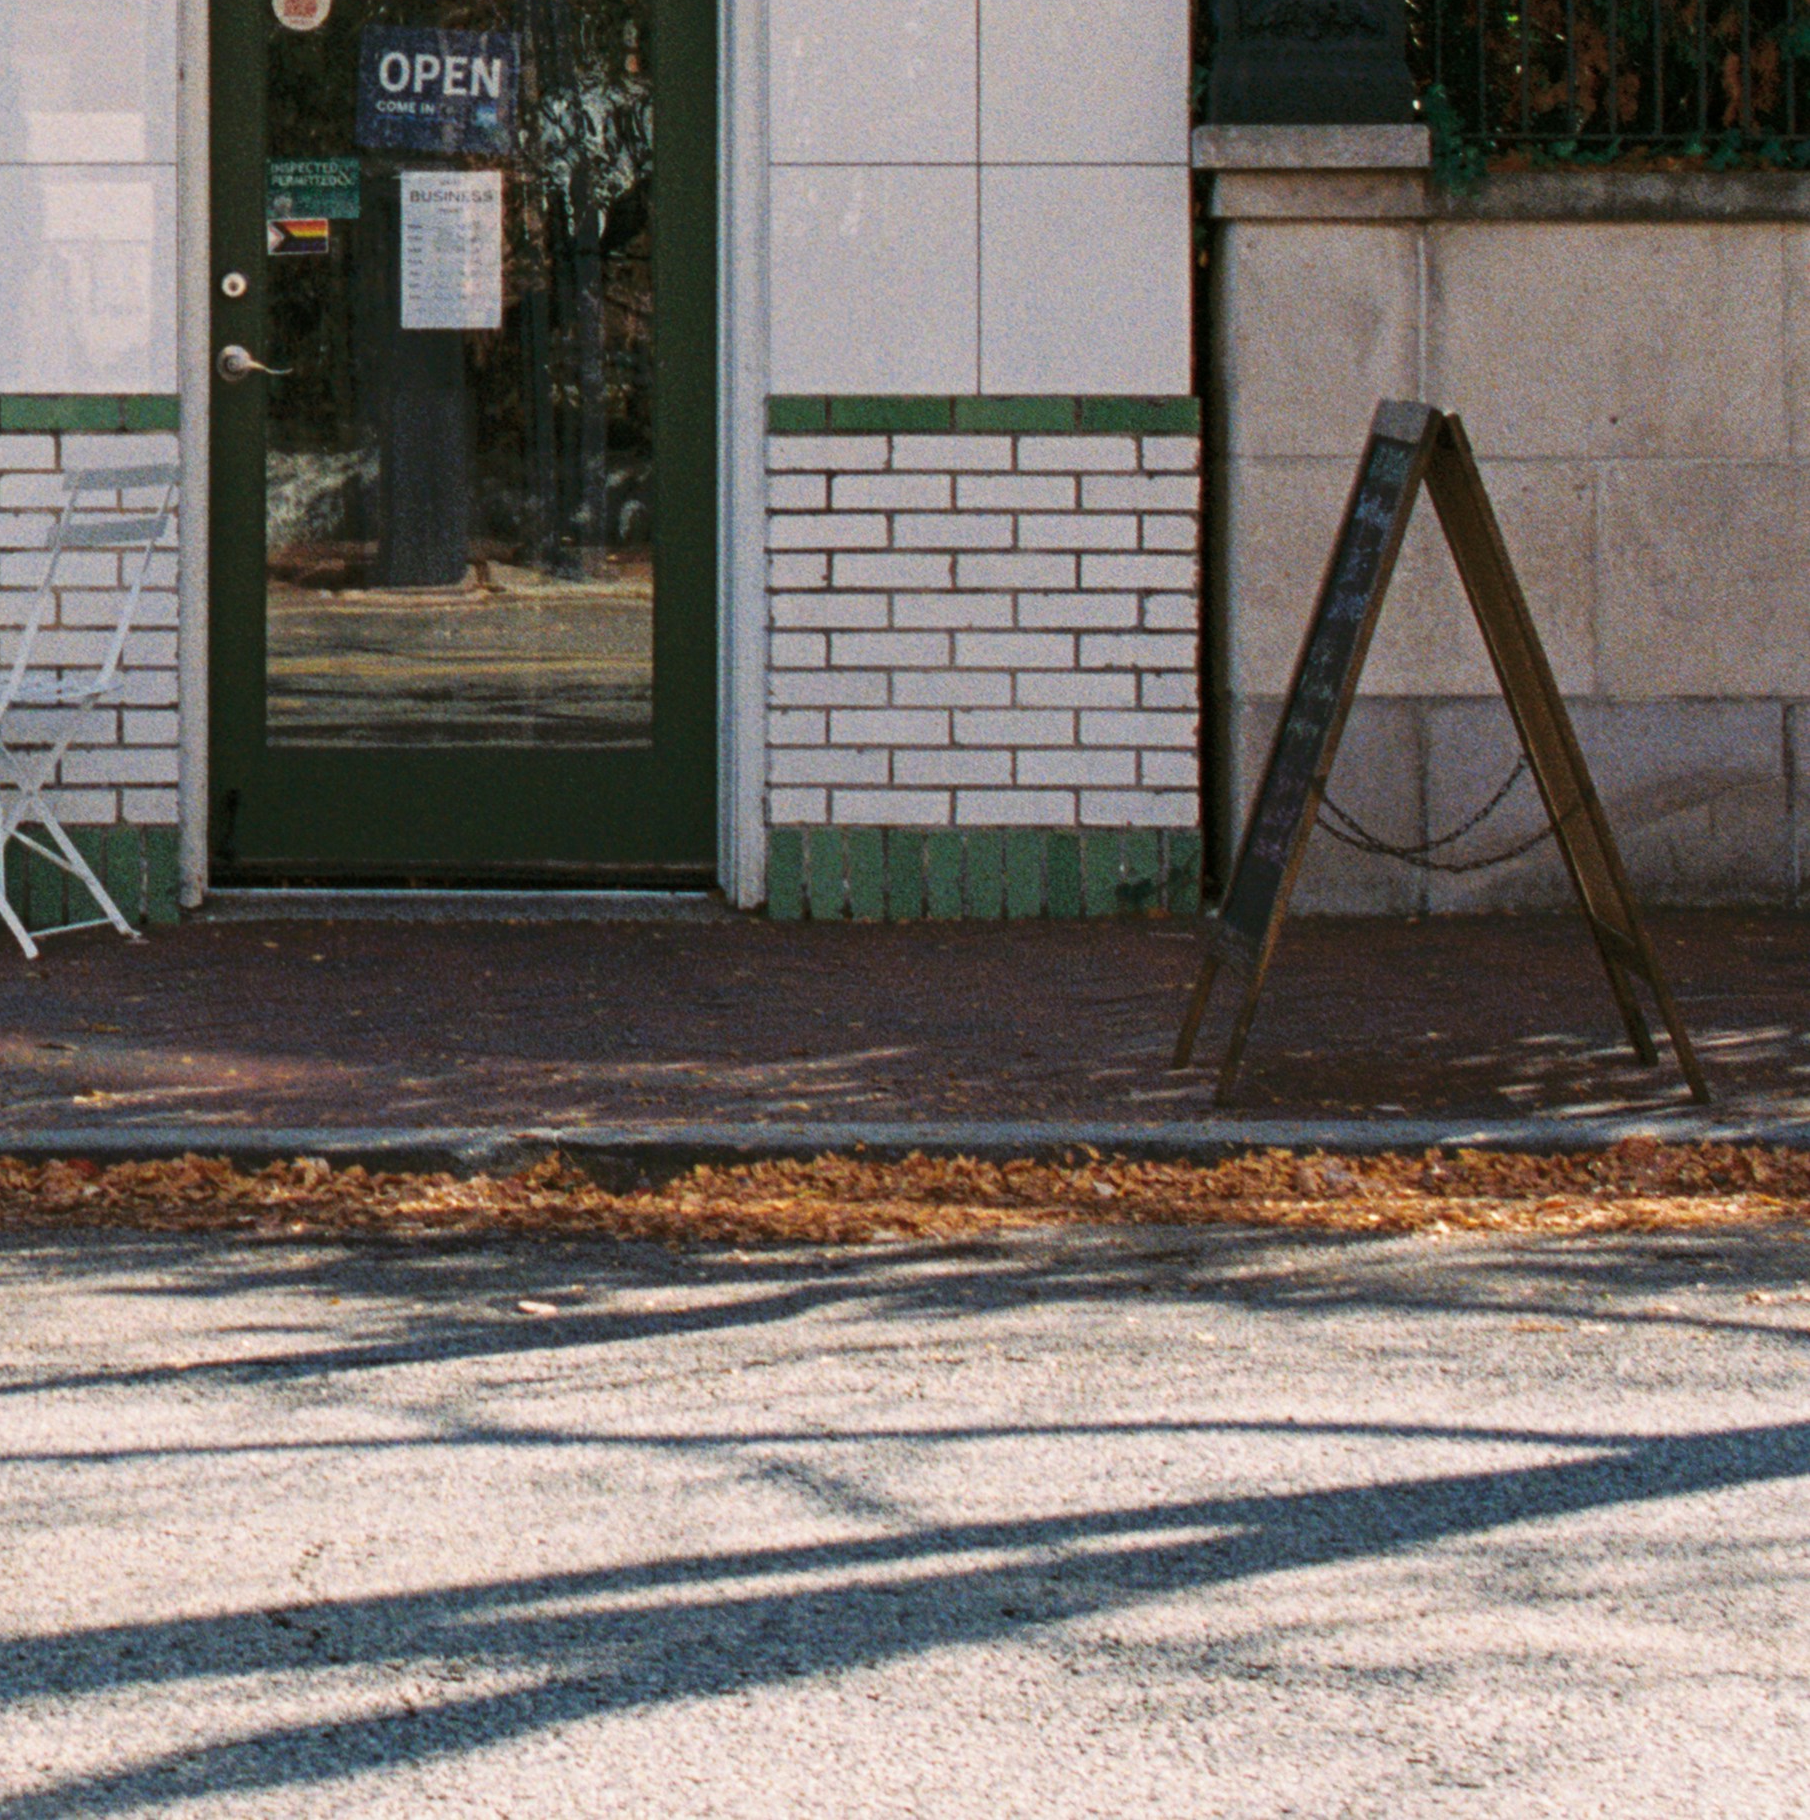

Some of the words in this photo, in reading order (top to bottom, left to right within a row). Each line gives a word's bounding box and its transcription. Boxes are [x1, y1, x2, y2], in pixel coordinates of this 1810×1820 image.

[378, 51, 502, 98] OPEN
[375, 100, 416, 114] COME
[420, 102, 435, 115] IN
[410, 189, 494, 203] BUSINESS
